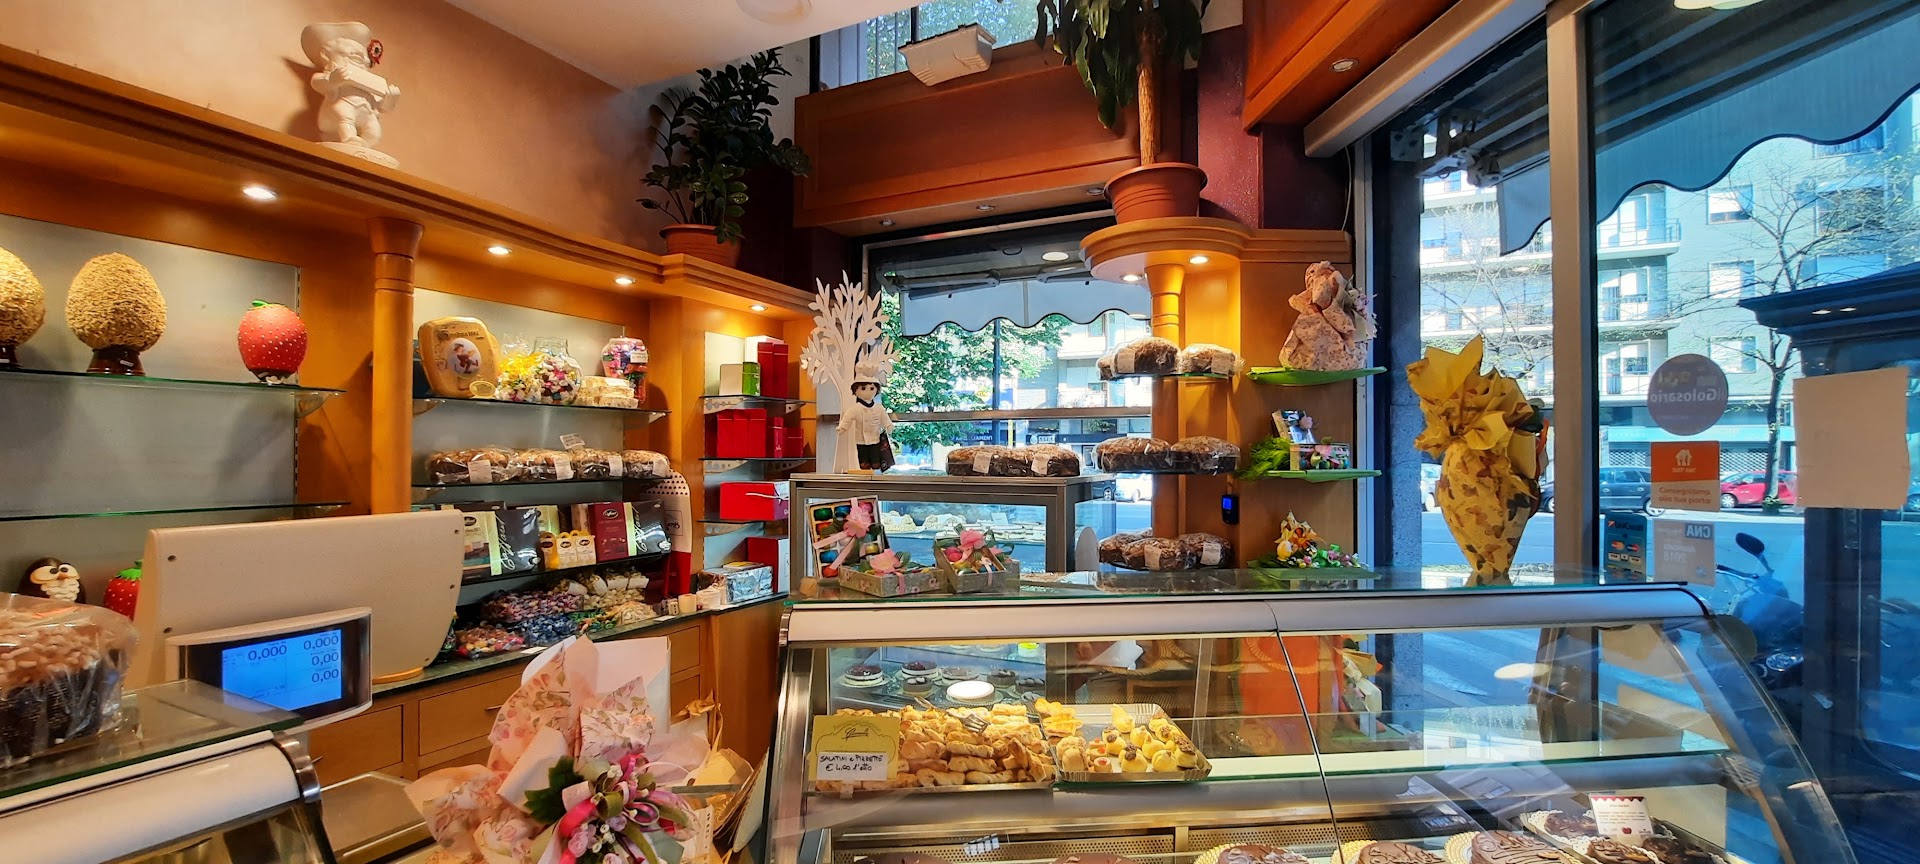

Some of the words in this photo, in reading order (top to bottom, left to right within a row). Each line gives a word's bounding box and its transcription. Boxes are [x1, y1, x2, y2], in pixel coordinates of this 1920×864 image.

[303, 635, 339, 650] 0,000
[248, 644, 287, 661] 0,000
[311, 652, 339, 666] 0,00
[311, 668, 339, 683] 0,00
